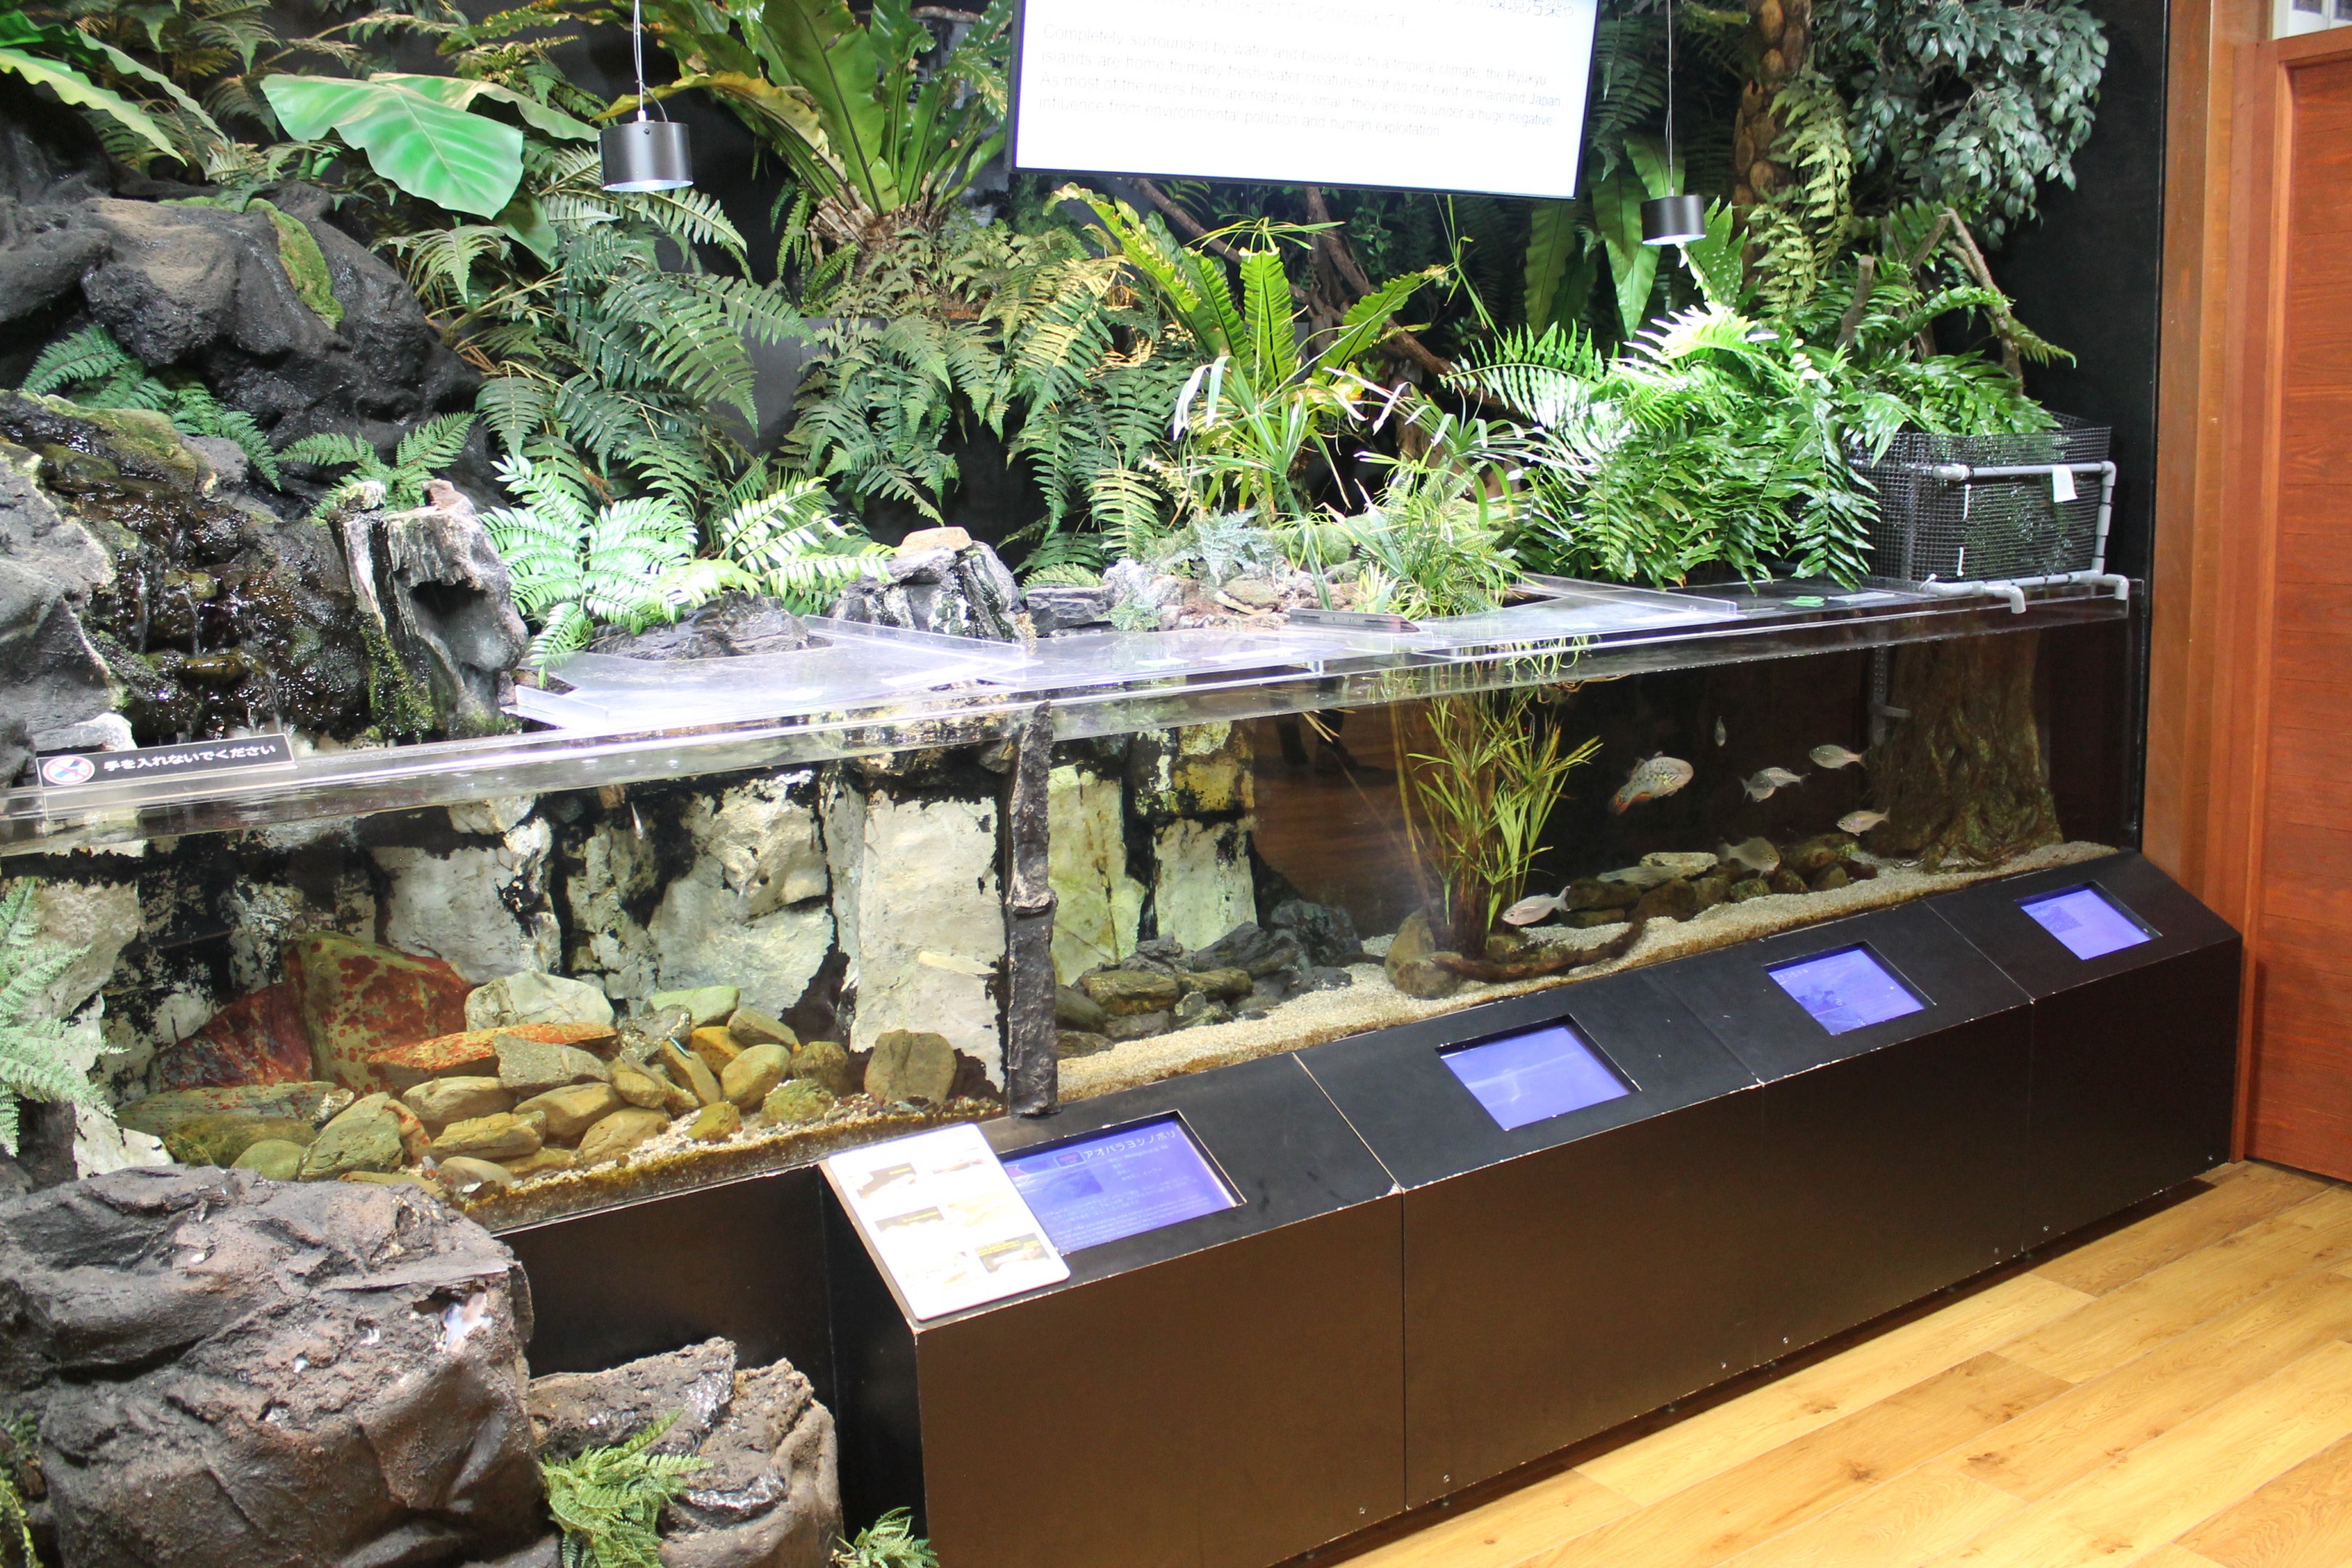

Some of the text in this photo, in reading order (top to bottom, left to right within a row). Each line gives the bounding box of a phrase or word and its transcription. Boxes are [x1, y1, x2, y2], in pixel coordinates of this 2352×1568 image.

[1043, 23, 1123, 46] Completely
[1131, 34, 1208, 52] surrounded
[1214, 40, 1228, 57] by
[1235, 44, 1269, 58] water
[1273, 46, 1297, 62] and
[1302, 48, 1348, 66] blessed
[1355, 53, 1378, 68] with
[1394, 59, 1434, 75] tropical
[1486, 66, 1504, 80] the
[1507, 68, 1547, 86] Ryukyu
[1040, 72, 1058, 88] As
[1064, 75, 1098, 90] most
[1104, 77, 1117, 91] of
[1122, 78, 1144, 94] the
[1149, 81, 1185, 97] rivers
[1191, 83, 1220, 99] here
[1225, 87, 1246, 100] are
[1251, 89, 1306, 109] relatively
[1352, 97, 1377, 115] they
[1381, 102, 1400, 114] are
[1405, 103, 1426, 115] now
[1432, 104, 1464, 118] under
[1478, 107, 1505, 125] huge
[1508, 112, 1553, 128] negative
[1098, 56, 1121, 69] are
[1126, 53, 1164, 72] home
[1169, 60, 1183, 73] to
[1187, 63, 1222, 79] many
[1228, 63, 1302, 83] fresh-water
[1304, 73, 1362, 89] creatures
[1368, 77, 1389, 91] that
[1393, 79, 1407, 93] do
[1411, 83, 1429, 95] not
[1434, 85, 1459, 98] exist
[1463, 86, 1473, 99] in
[1477, 88, 1526, 105] mainland
[1039, 97, 1103, 113] influence
[1109, 100, 1140, 115] from
[1146, 104, 1239, 123] environmental
[1245, 110, 1297, 127] pollution
[1302, 115, 1326, 128] and
[1331, 117, 1372, 132] human
[103, 745, 277, 772] 手を入れないでください
[1083, 1130, 1175, 1159] アオバラヨシノボリ
